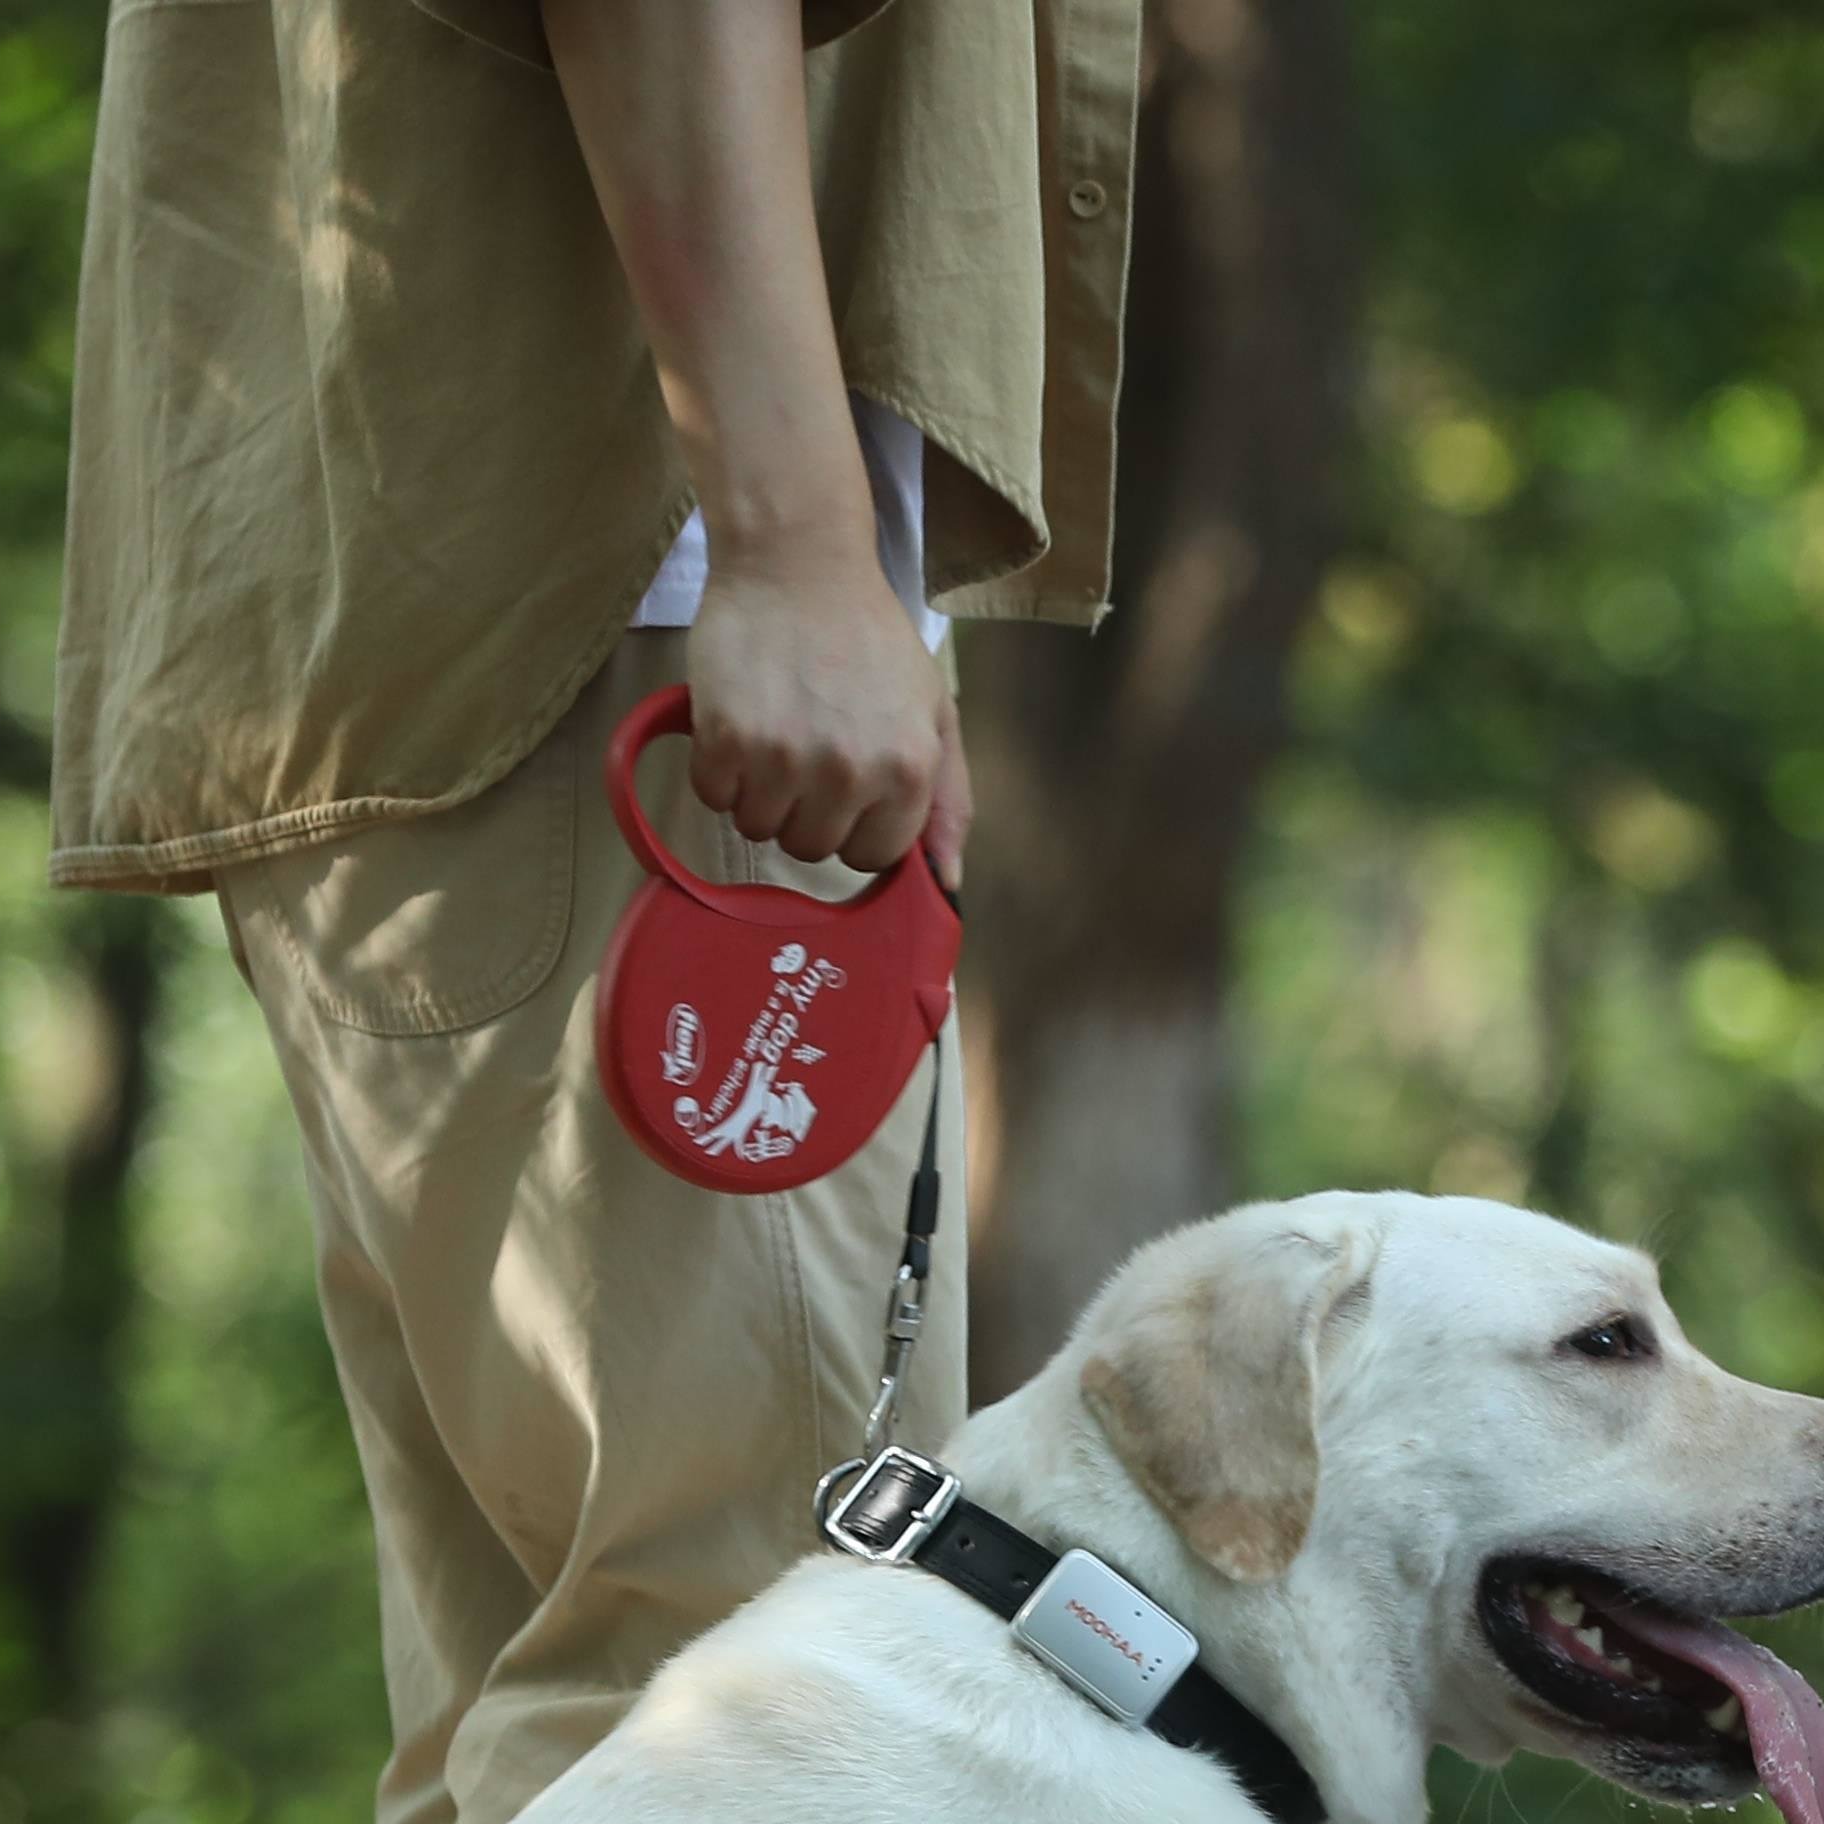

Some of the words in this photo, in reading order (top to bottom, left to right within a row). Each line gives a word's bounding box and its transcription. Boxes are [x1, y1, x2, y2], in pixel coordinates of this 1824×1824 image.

[766, 996, 781, 1010] a
[791, 966, 823, 1013] my
[742, 1010, 775, 1060] super
[757, 1012, 799, 1064] dog
